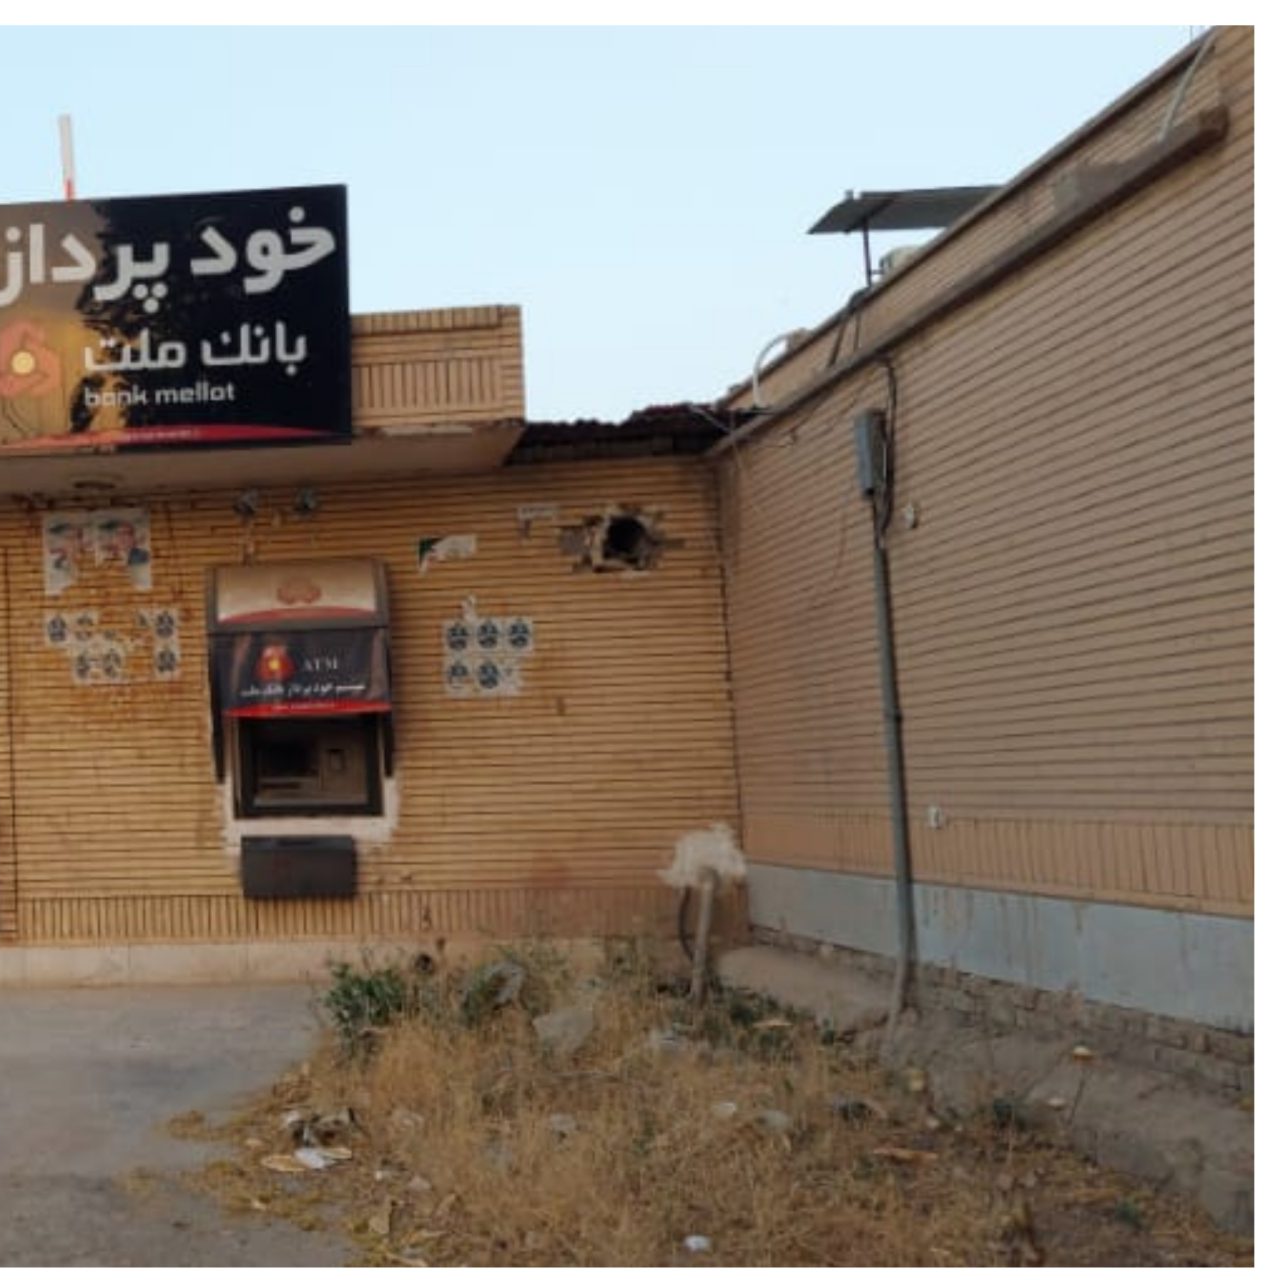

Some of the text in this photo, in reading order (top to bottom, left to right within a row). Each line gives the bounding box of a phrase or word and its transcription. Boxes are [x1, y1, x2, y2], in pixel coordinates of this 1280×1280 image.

[190, 206, 336, 295] خود
[84, 327, 187, 371] ملت
[84, 383, 147, 408] bank
